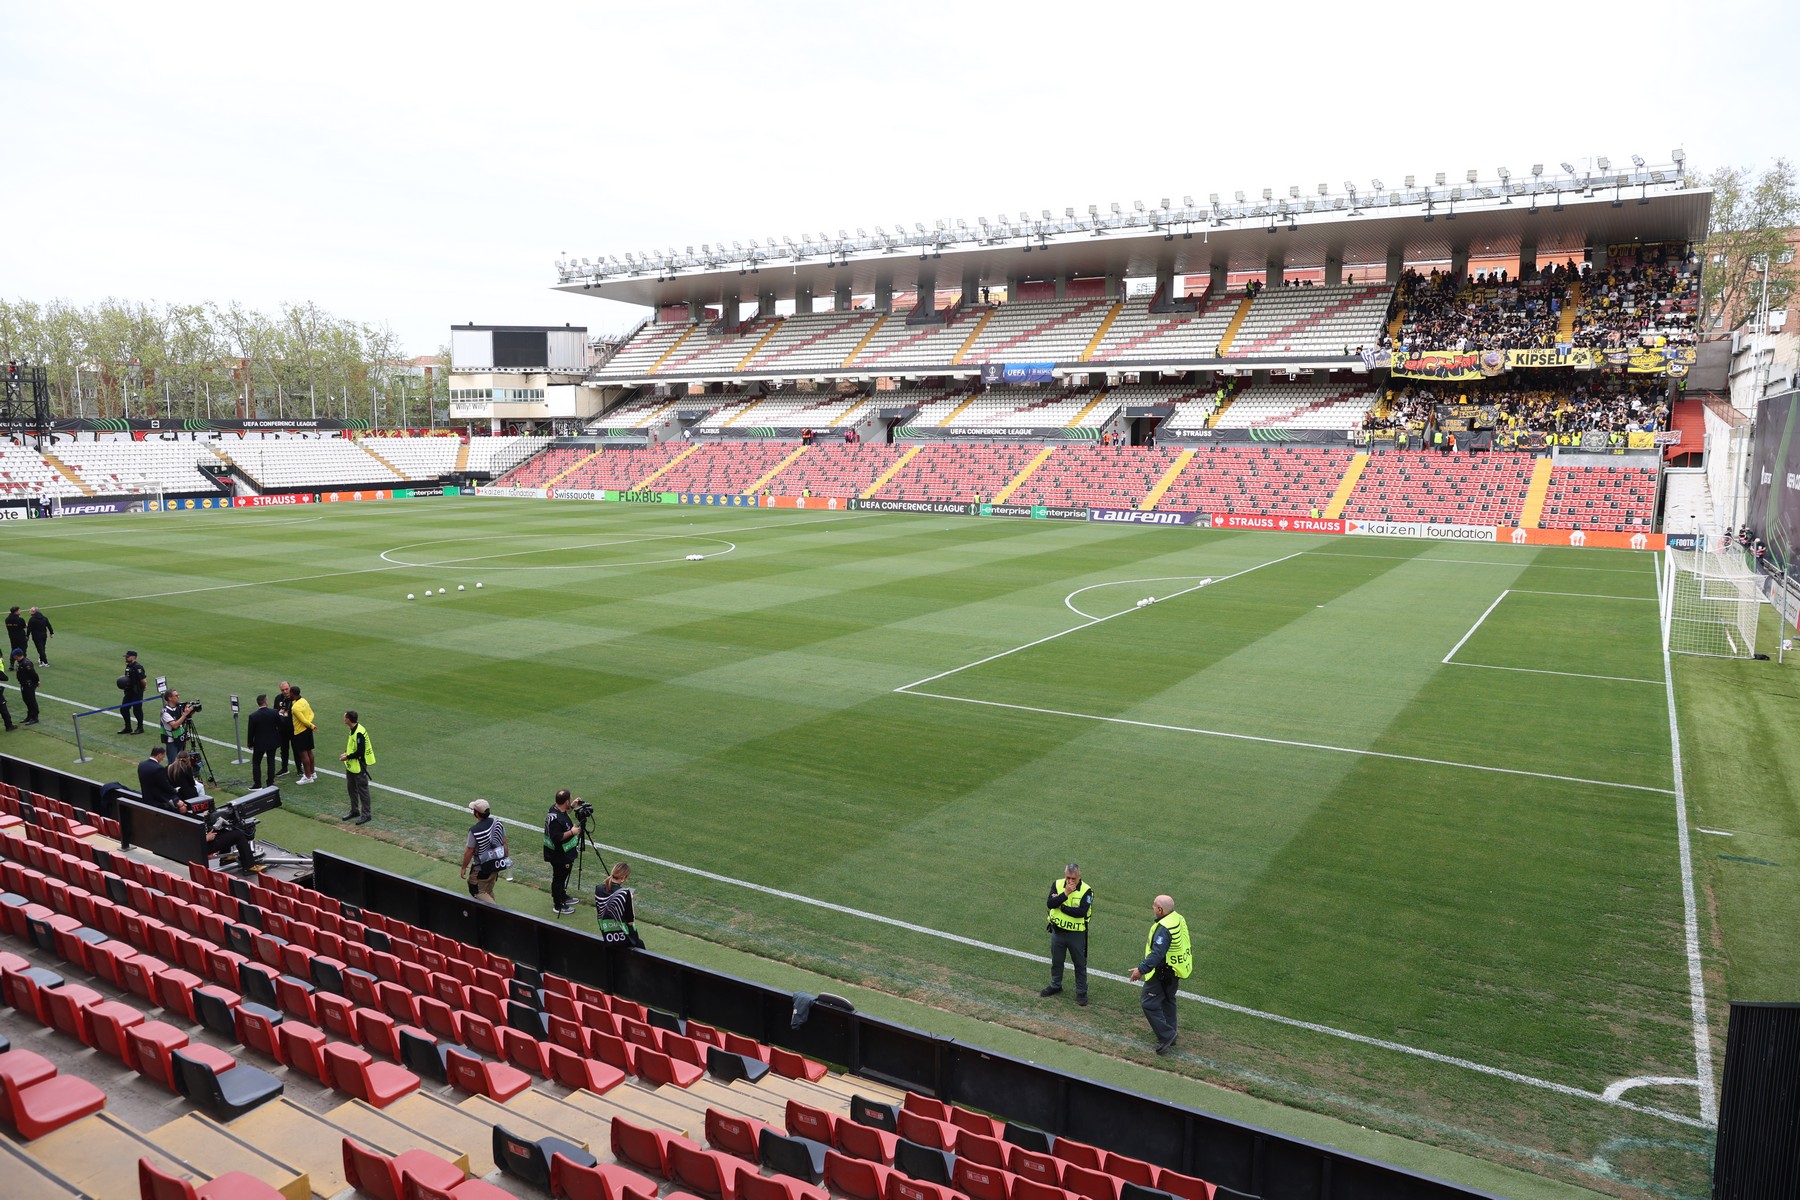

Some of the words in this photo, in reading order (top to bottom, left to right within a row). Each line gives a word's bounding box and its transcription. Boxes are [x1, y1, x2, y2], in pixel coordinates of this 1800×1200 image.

[1516, 354, 1567, 365] KIPSELI
[456, 403, 471, 411] Willy!
[472, 403, 488, 411] Willy!
[407, 488, 443, 497] enterprise
[484, 488, 505, 496] kaizen
[508, 489, 536, 498] foundation
[555, 489, 595, 500] Swissquote
[253, 496, 296, 506] STRAUSS
[860, 502, 881, 510] UEFA
[882, 503, 932, 512] CONFERENCE
[934, 505, 965, 513] LEAGUE
[983, 505, 1031, 516] enterprise
[1037, 506, 1087, 518] enterprise
[1229, 517, 1273, 527] STRAUSS
[1293, 520, 1340, 531] STRAUSS
[1368, 522, 1416, 535] kaizen
[1426, 525, 1493, 539] foundation
[606, 932, 626, 942] 003
